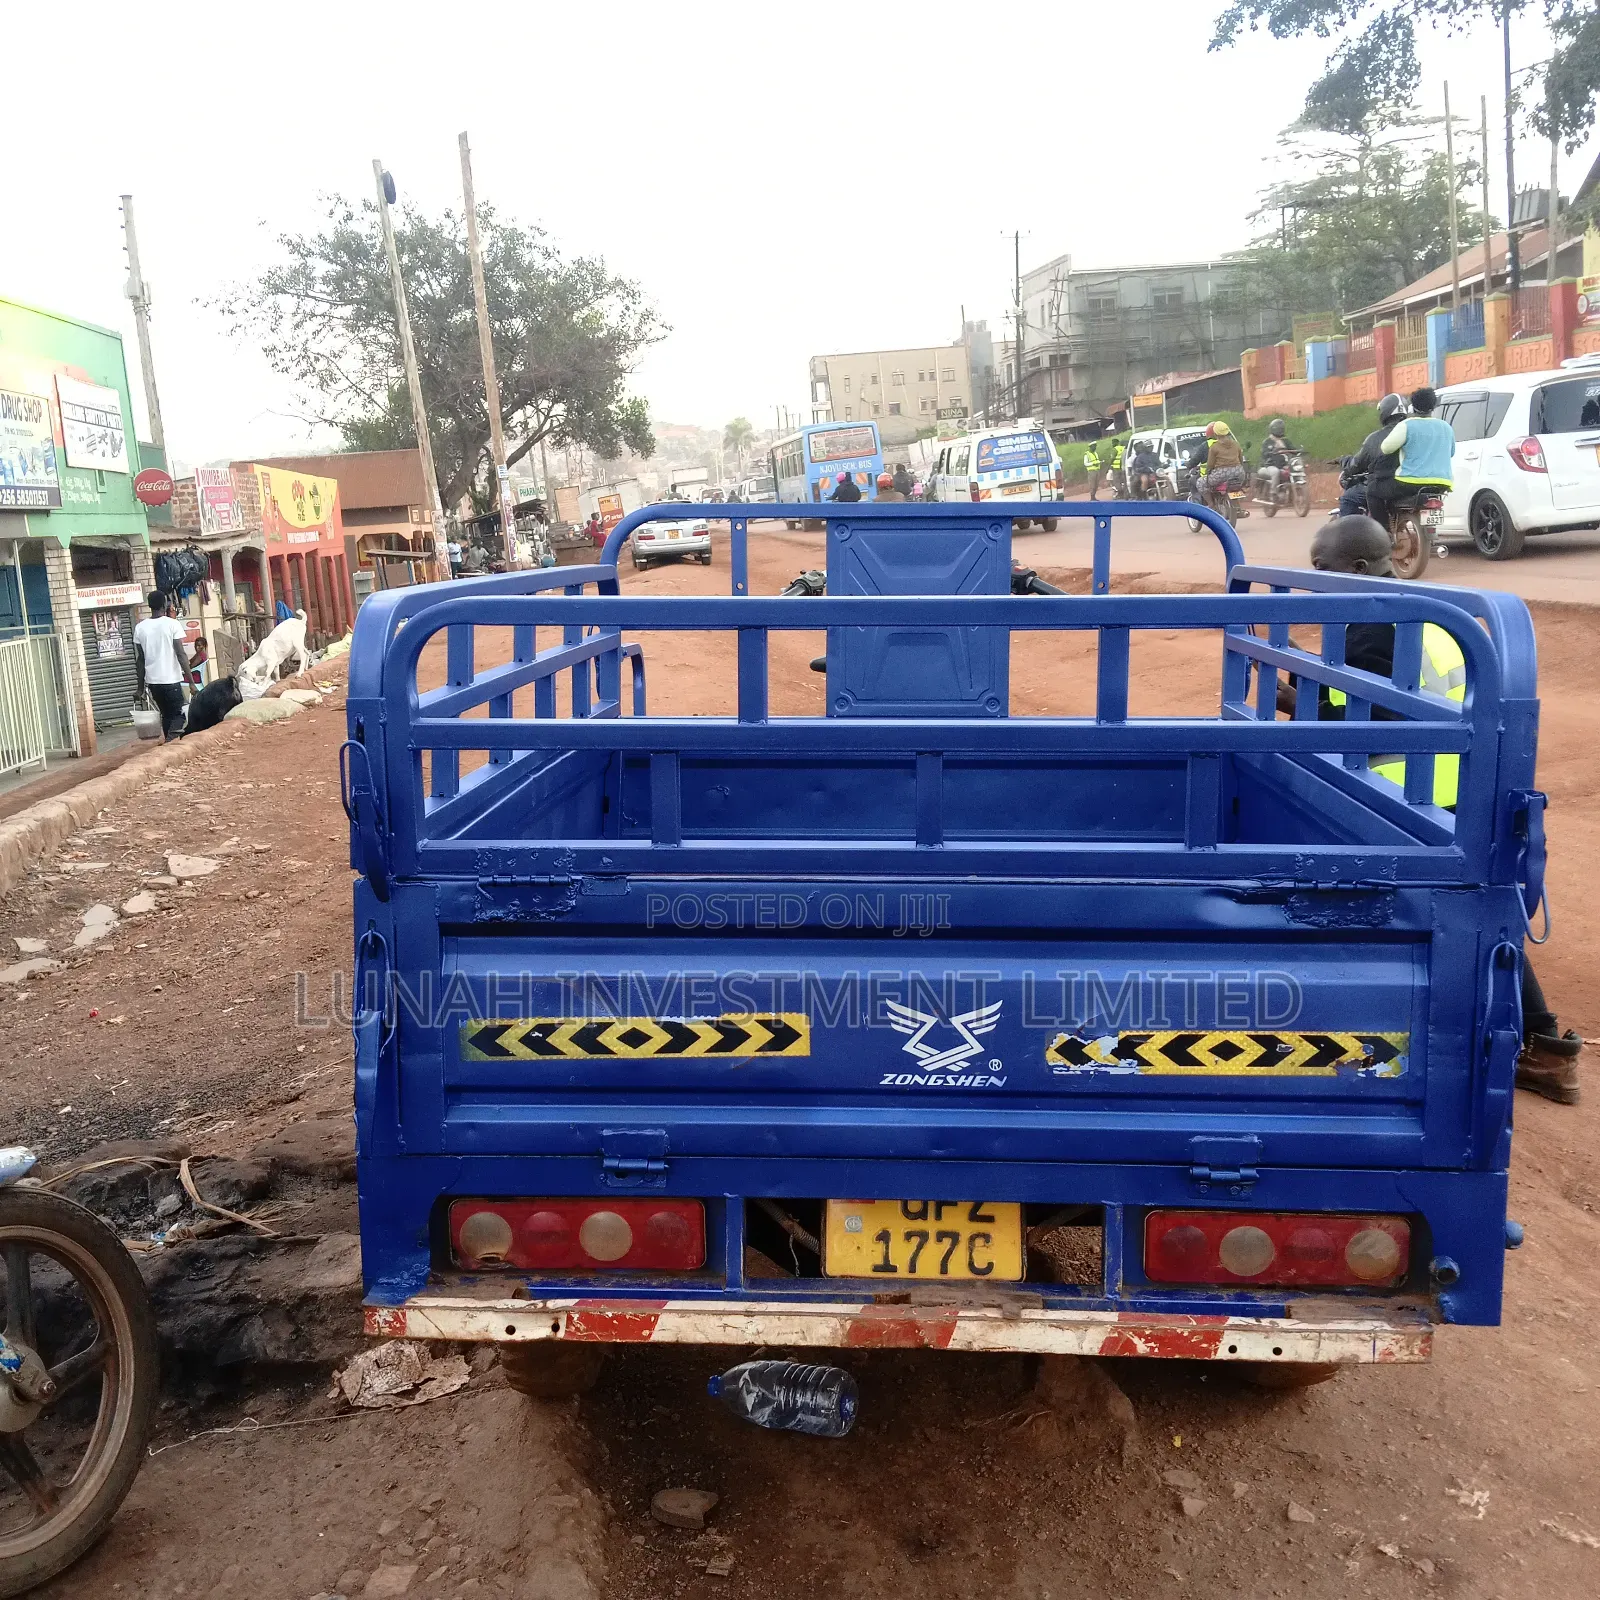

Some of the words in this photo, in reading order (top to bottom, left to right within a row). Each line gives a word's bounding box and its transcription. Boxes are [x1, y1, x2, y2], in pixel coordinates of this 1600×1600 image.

[1, 393, 23, 421] DRUG
[23, 397, 43, 423] SHOP
[941, 408, 964, 417] NINA
[997, 435, 1038, 447] SIMBA
[1180, 432, 1201, 440] ALLAH
[993, 442, 1045, 455] CEMENT
[820, 463, 841, 474] NJOVU
[858, 459, 873, 470] BUS
[879, 1073, 1008, 1088] ZONGSHEN
[871, 1228, 996, 1276] 177C
